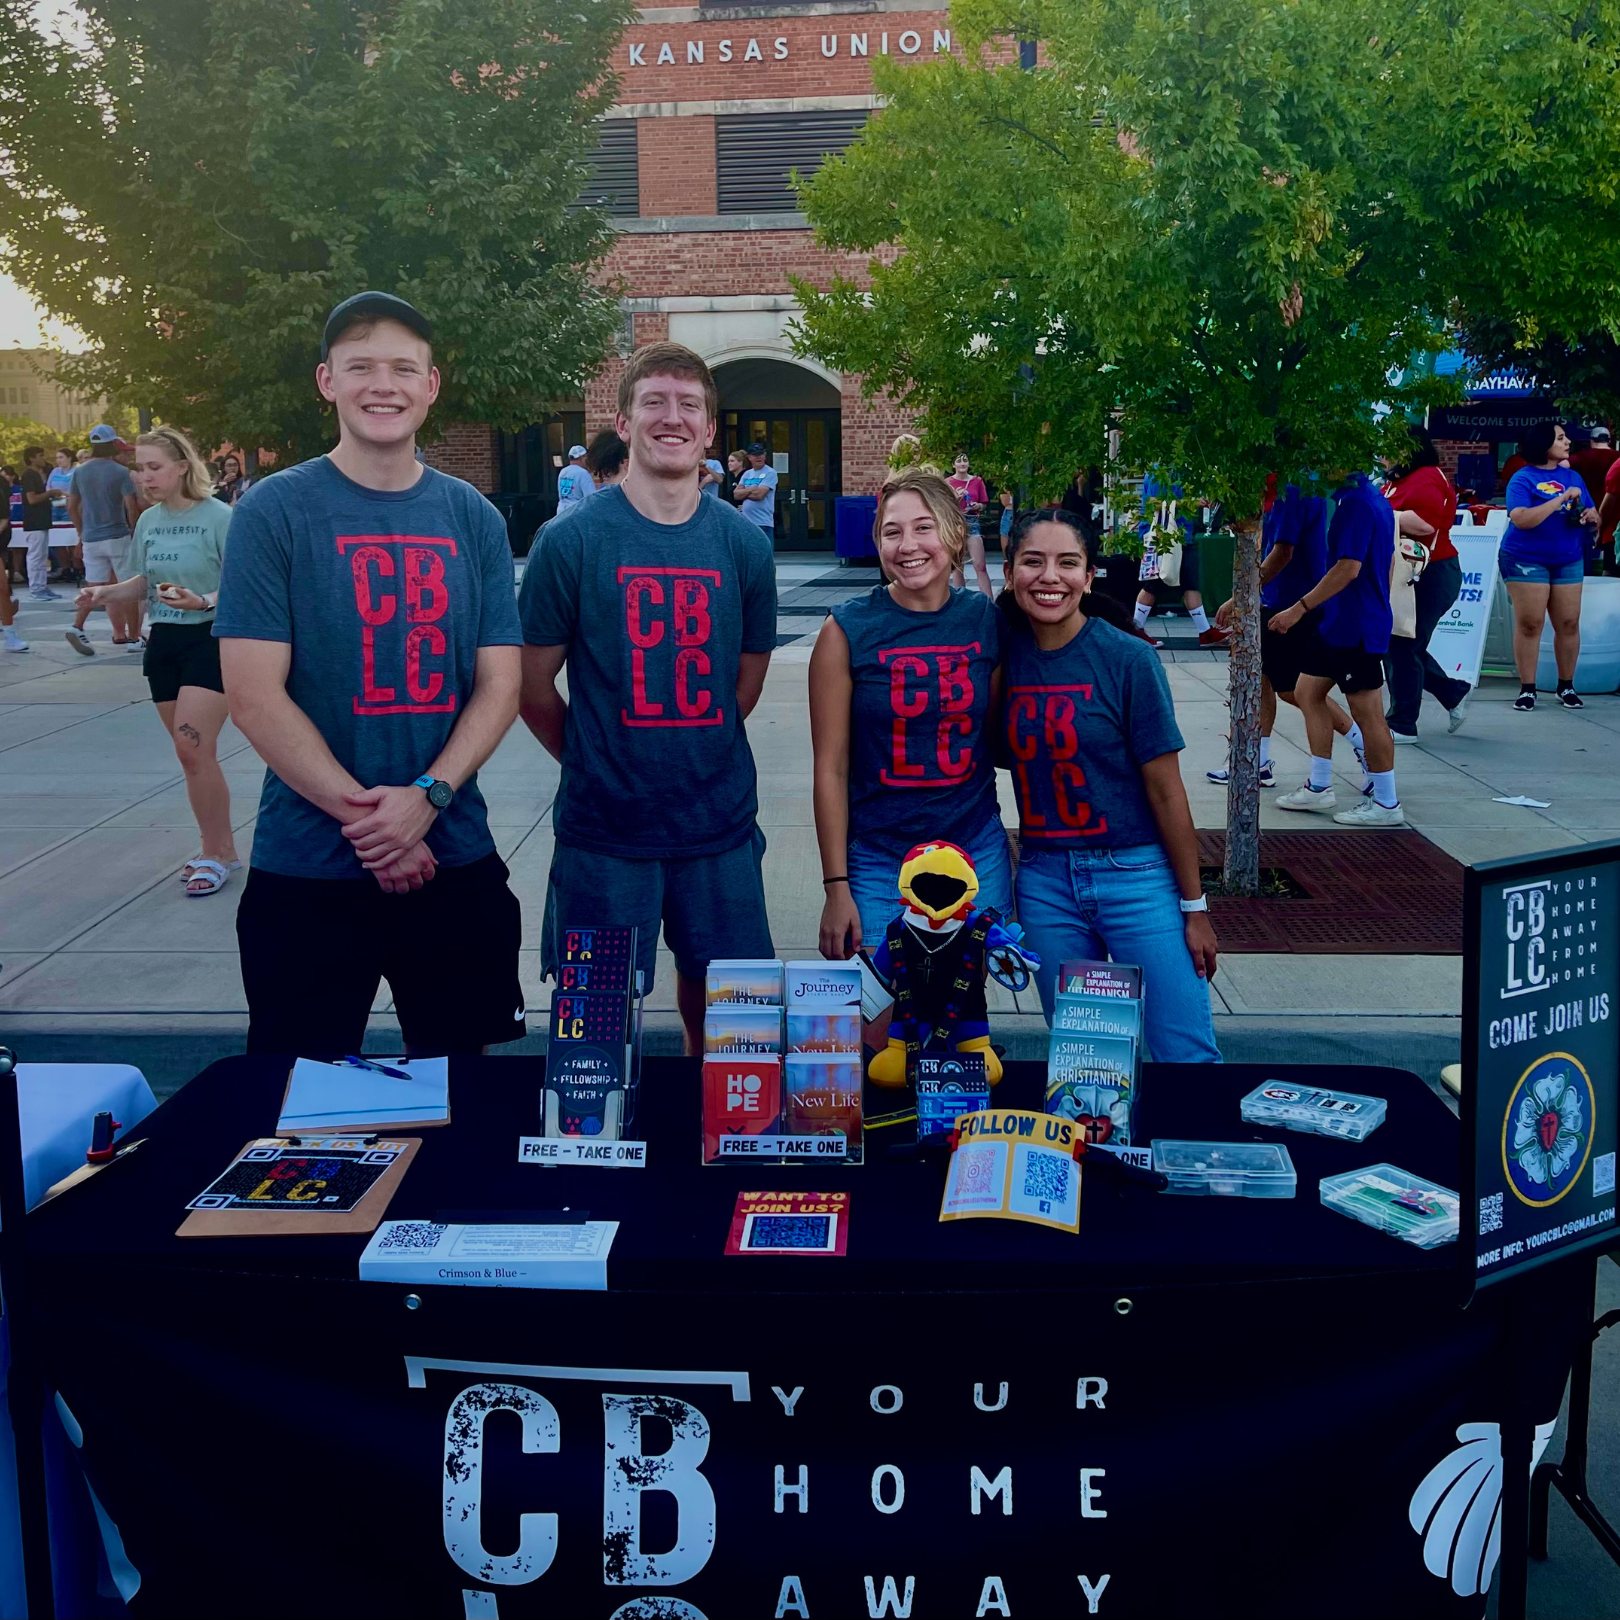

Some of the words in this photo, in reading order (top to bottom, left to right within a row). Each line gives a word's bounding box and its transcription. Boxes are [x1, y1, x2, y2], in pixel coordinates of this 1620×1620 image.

[629, 37, 789, 66] KANSAS
[821, 29, 951, 58] UNION
[1447, 414, 1504, 427] WELCOME
[148, 525, 208, 536] UNIVERSITY
[352, 545, 449, 626] CB
[626, 576, 712, 649] CB
[362, 625, 447, 703] LC
[631, 648, 712, 717] LC
[890, 654, 975, 718] CB
[1008, 695, 1078, 761] CB
[892, 713, 973, 777] LC
[1017, 761, 1091, 828] LC
[1553, 876, 1597, 895] YOUR
[1506, 889, 1546, 941] CB
[1551, 899, 1597, 917] HOME
[1551, 920, 1597, 940] AWAY
[567, 932, 592, 952] CB
[1552, 942, 1597, 962] FROM
[1507, 936, 1546, 990] LC
[563, 967, 588, 987] CB
[1086, 979, 1123, 988] EXPLANATION
[1091, 970, 1112, 979] SIMPLE
[1551, 963, 1596, 984] HOME
[732, 985, 752, 997] THE
[795, 982, 855, 998] Journey
[558, 998, 585, 1019] CB
[1068, 1006, 1101, 1019] SIMPLE
[557, 1018, 584, 1039] LC
[1062, 1018, 1120, 1034] EXPLANATION
[1120, 1026, 1129, 1034] OF
[1489, 1010, 1538, 1049] COME
[1543, 999, 1583, 1035] JOIN
[1588, 992, 1610, 1023] US
[734, 1033, 754, 1043] THE
[1056, 1045, 1061, 1053] A
[1061, 1042, 1095, 1056] SIMPLE
[572, 1059, 601, 1069] FAMILY
[1055, 1055, 1115, 1070] EXPLANATION
[1115, 1062, 1124, 1070] OF
[560, 1074, 611, 1084] FELLOWSHIP
[1055, 1067, 1123, 1087] CHRISTIANITY
[573, 1090, 597, 1099] FAITH
[791, 1093, 826, 1108] New
[831, 1093, 860, 1108] Life
[959, 1114, 1036, 1139] FOLLOW
[1044, 1120, 1073, 1145] US
[331, 1140, 358, 1149] US
[523, 1143, 558, 1157] FREE
[576, 1145, 612, 1159] TAKE
[617, 1147, 643, 1160] ONE
[723, 1140, 758, 1153] FREE
[777, 1141, 812, 1153] TAKE
[818, 1141, 844, 1153] ONE
[267, 1158, 343, 1180] CB
[1121, 1153, 1149, 1166] ONE
[246, 1179, 327, 1201] LC
[743, 1192, 808, 1201] WANT
[816, 1192, 846, 1201] TO
[740, 1204, 792, 1213] JOIN
[799, 1204, 844, 1213] US?
[1476, 1248, 1501, 1269] MORE
[1502, 1241, 1524, 1259] INFO:
[1526, 1207, 1616, 1250] YOURCBLC@GMAIL.COM
[438, 1268, 481, 1278] Crimson
[483, 1268, 492, 1278] &
[495, 1268, 518, 1278] Blue
[771, 1377, 1108, 1416] YOUR
[443, 1384, 716, 1585] CB
[774, 1464, 1107, 1518] HOME
[774, 1574, 1111, 1619] AWAY
